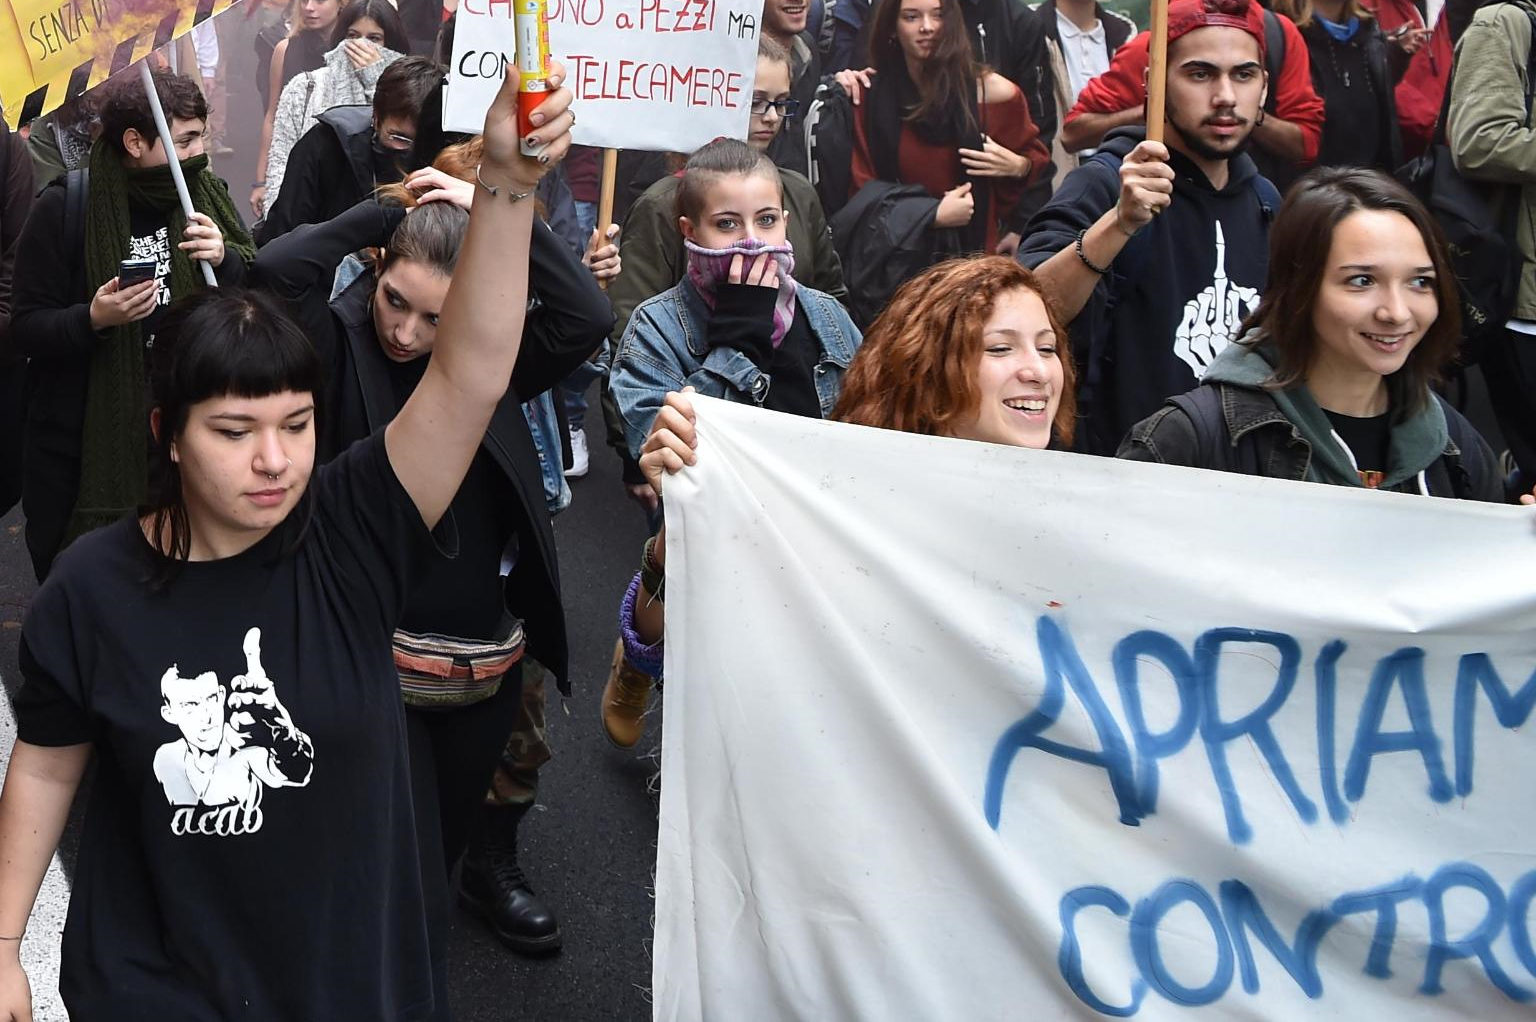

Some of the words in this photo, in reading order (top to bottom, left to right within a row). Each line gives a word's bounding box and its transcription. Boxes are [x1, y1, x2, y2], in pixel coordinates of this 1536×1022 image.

[29, 0, 89, 61] SENZA
[728, 10, 756, 40] MA
[566, 55, 743, 108] TELECAMERE
